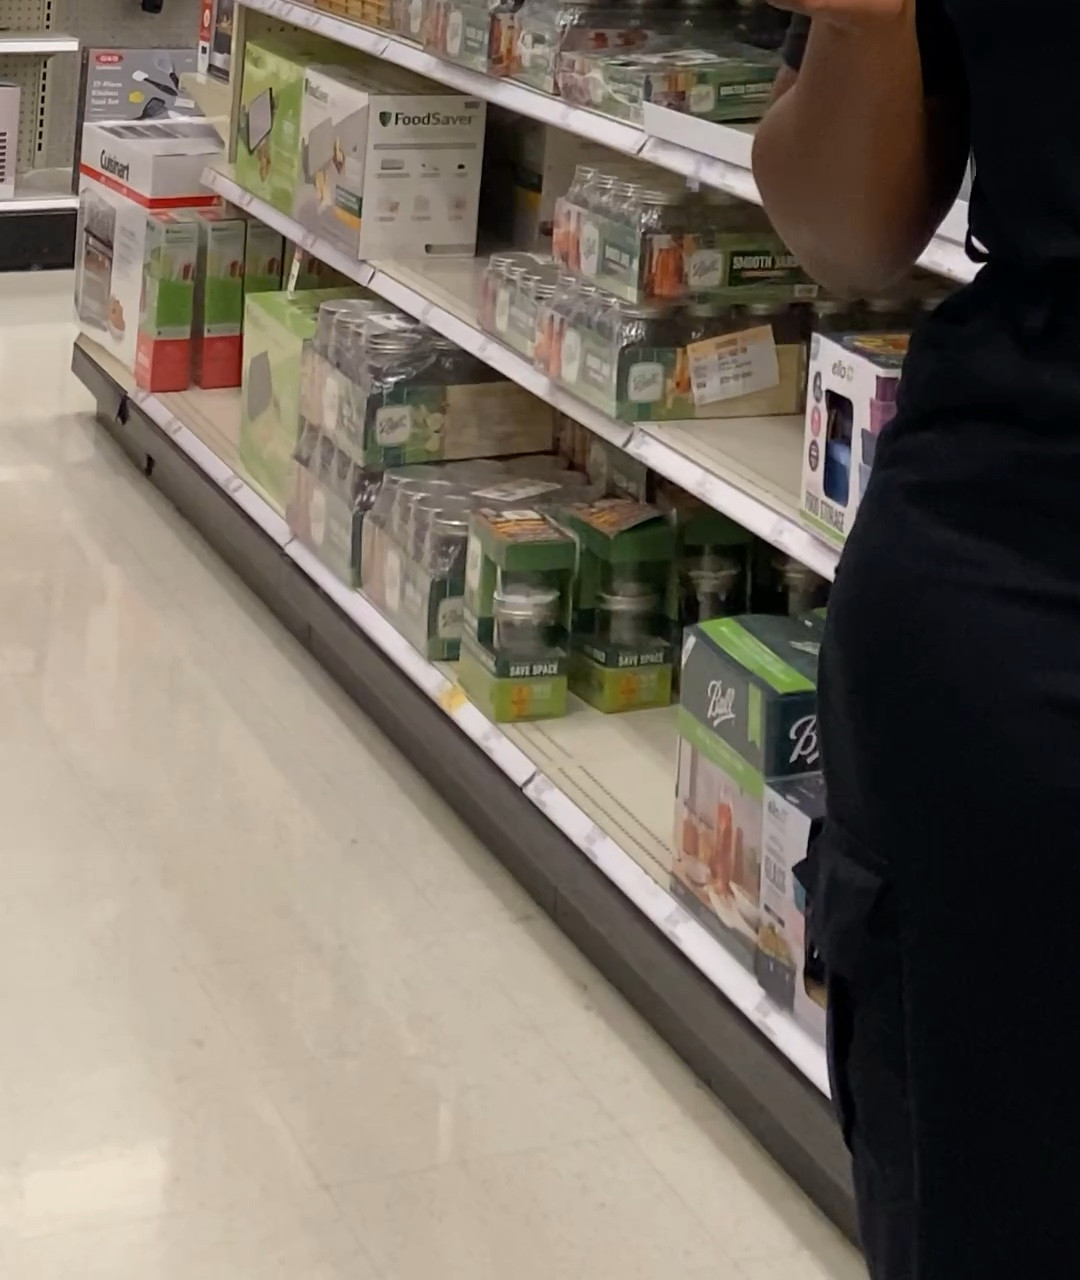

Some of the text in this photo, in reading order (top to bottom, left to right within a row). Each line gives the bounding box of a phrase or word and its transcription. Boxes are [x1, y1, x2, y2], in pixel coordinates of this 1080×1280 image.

[395, 112, 473, 126] FoodSaver
[101, 149, 130, 181] Cuisinart
[510, 665, 530, 677] SAVE
